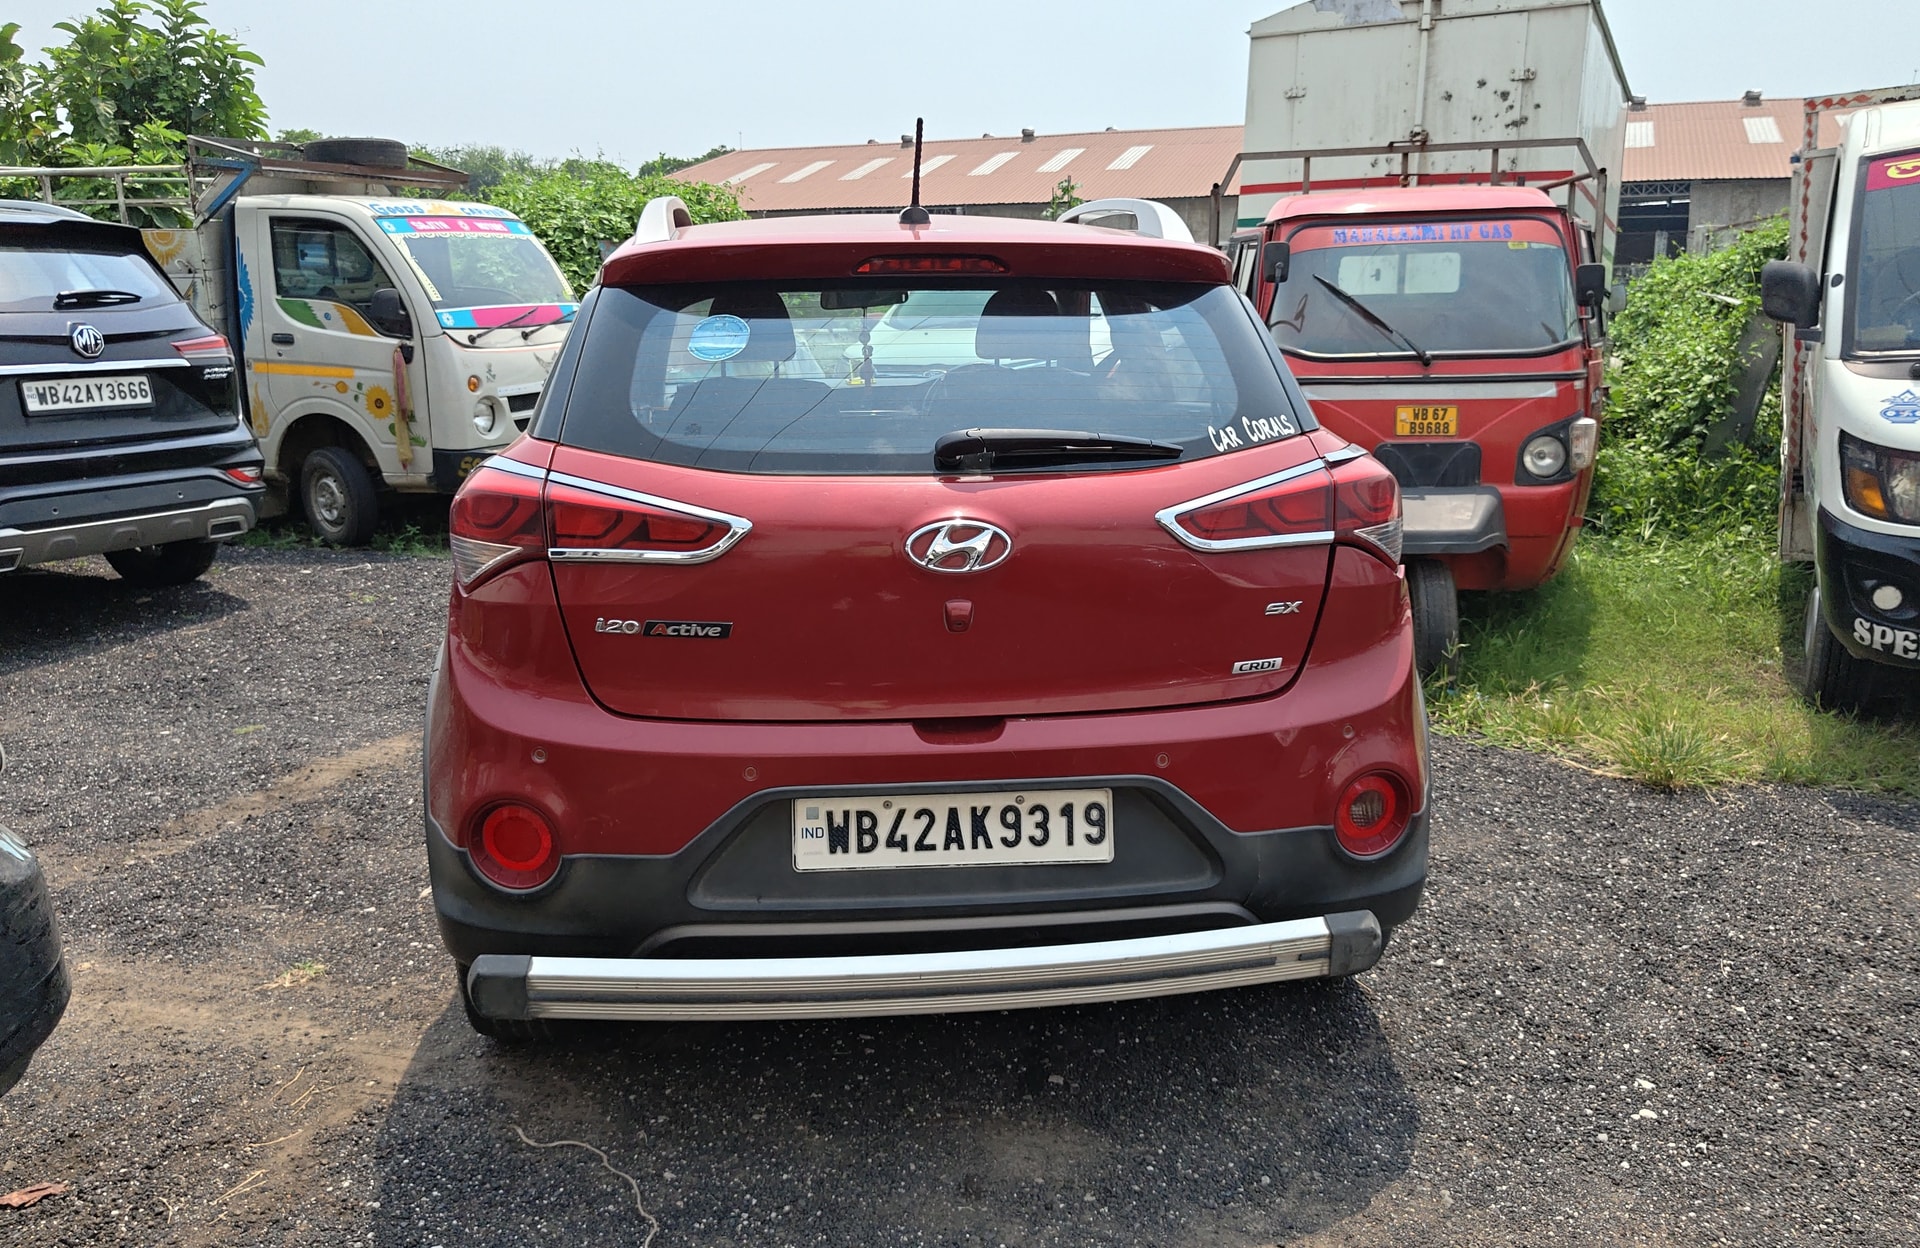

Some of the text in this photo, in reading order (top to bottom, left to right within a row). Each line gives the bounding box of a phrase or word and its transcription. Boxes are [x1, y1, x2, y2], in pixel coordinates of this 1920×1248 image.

[1450, 224, 1474, 240] HP
[1479, 224, 1513, 239] GAS
[76, 327, 102, 354] MG
[35, 380, 149, 406] WB42AY3666
[1413, 408, 1448, 421] WB 67
[1208, 414, 1295, 452] CAR CORALS
[1409, 422, 1450, 434] B9688
[1265, 601, 1303, 616] SX
[595, 617, 722, 637] i20 Active
[1853, 617, 1920, 660] SPE
[1238, 660, 1277, 672] CRDi
[801, 803, 1106, 854] IND WB42AK9319
